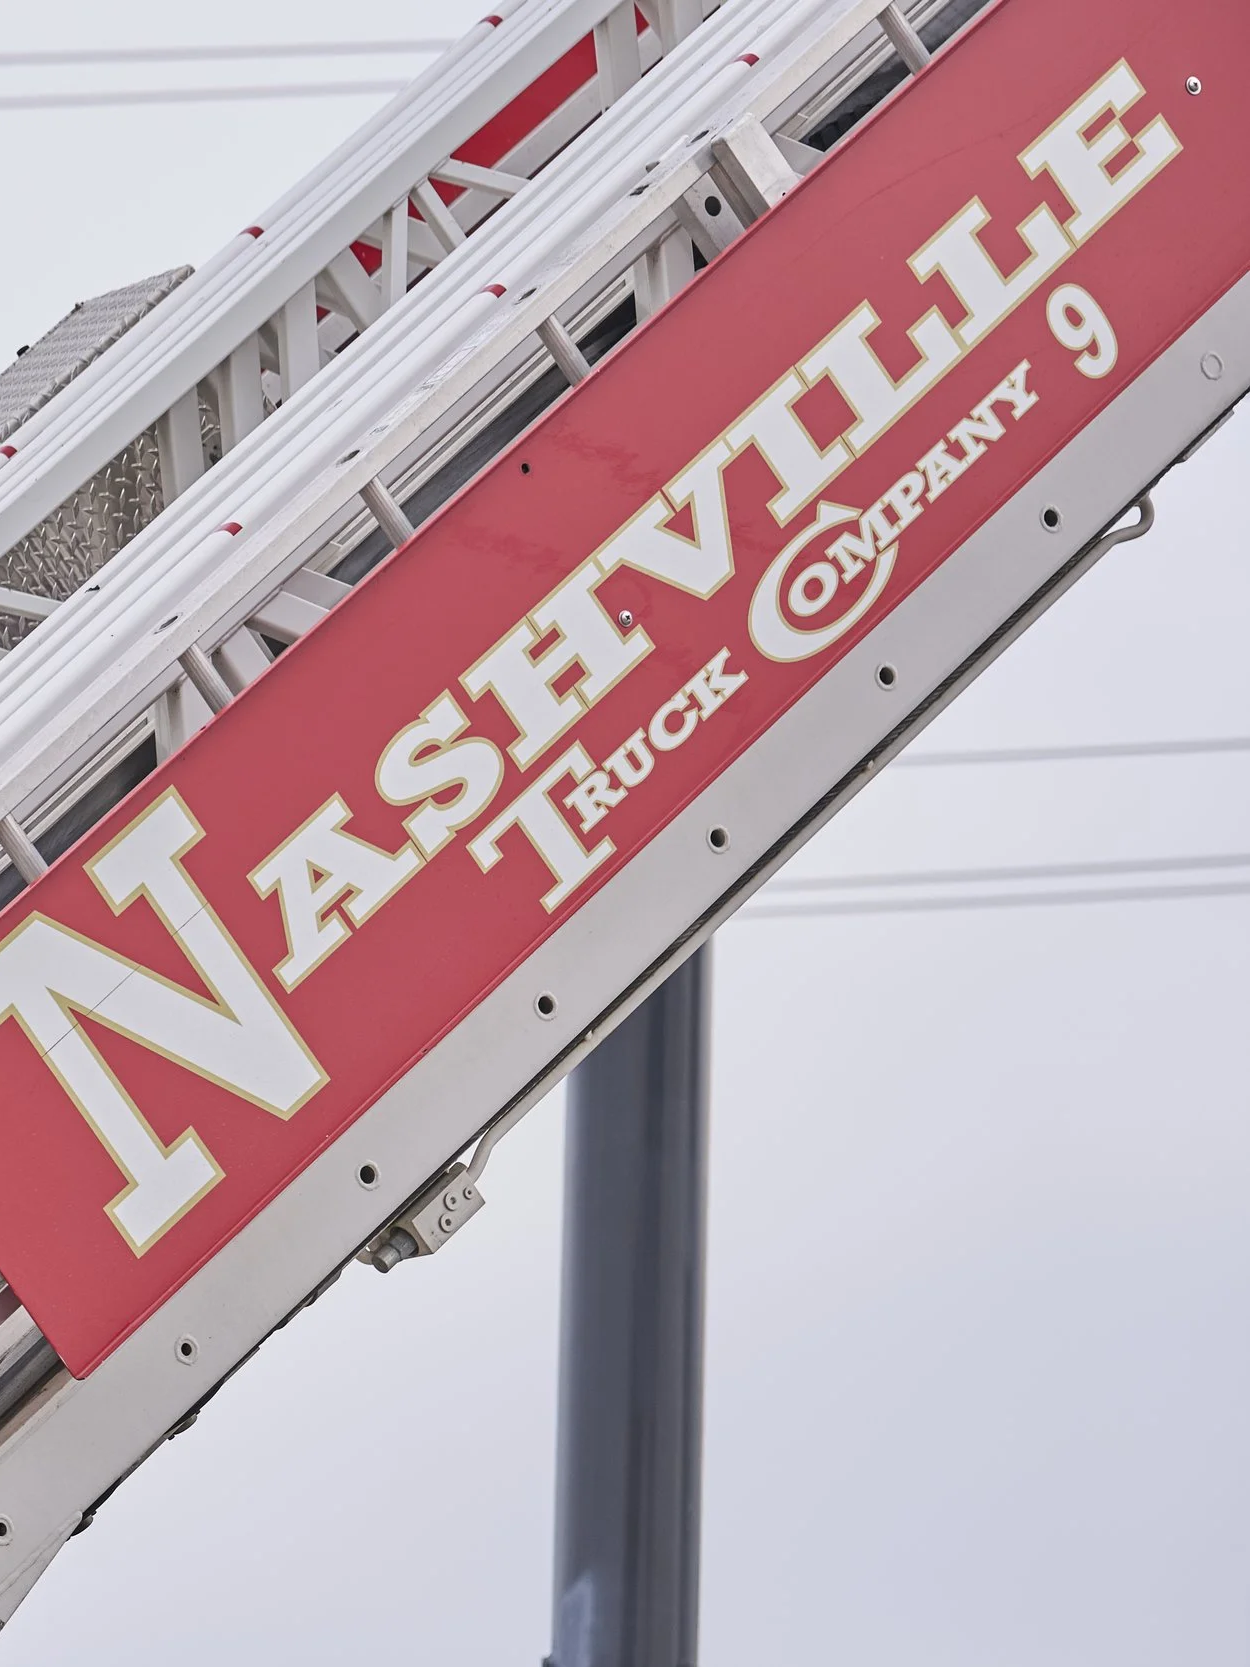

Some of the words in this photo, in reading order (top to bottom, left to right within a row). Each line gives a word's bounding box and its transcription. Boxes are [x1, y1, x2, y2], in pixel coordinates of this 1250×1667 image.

[466, 647, 749, 914] TRUCK
[748, 359, 1040, 662] COMPANY
[1046, 283, 1118, 379] 9
